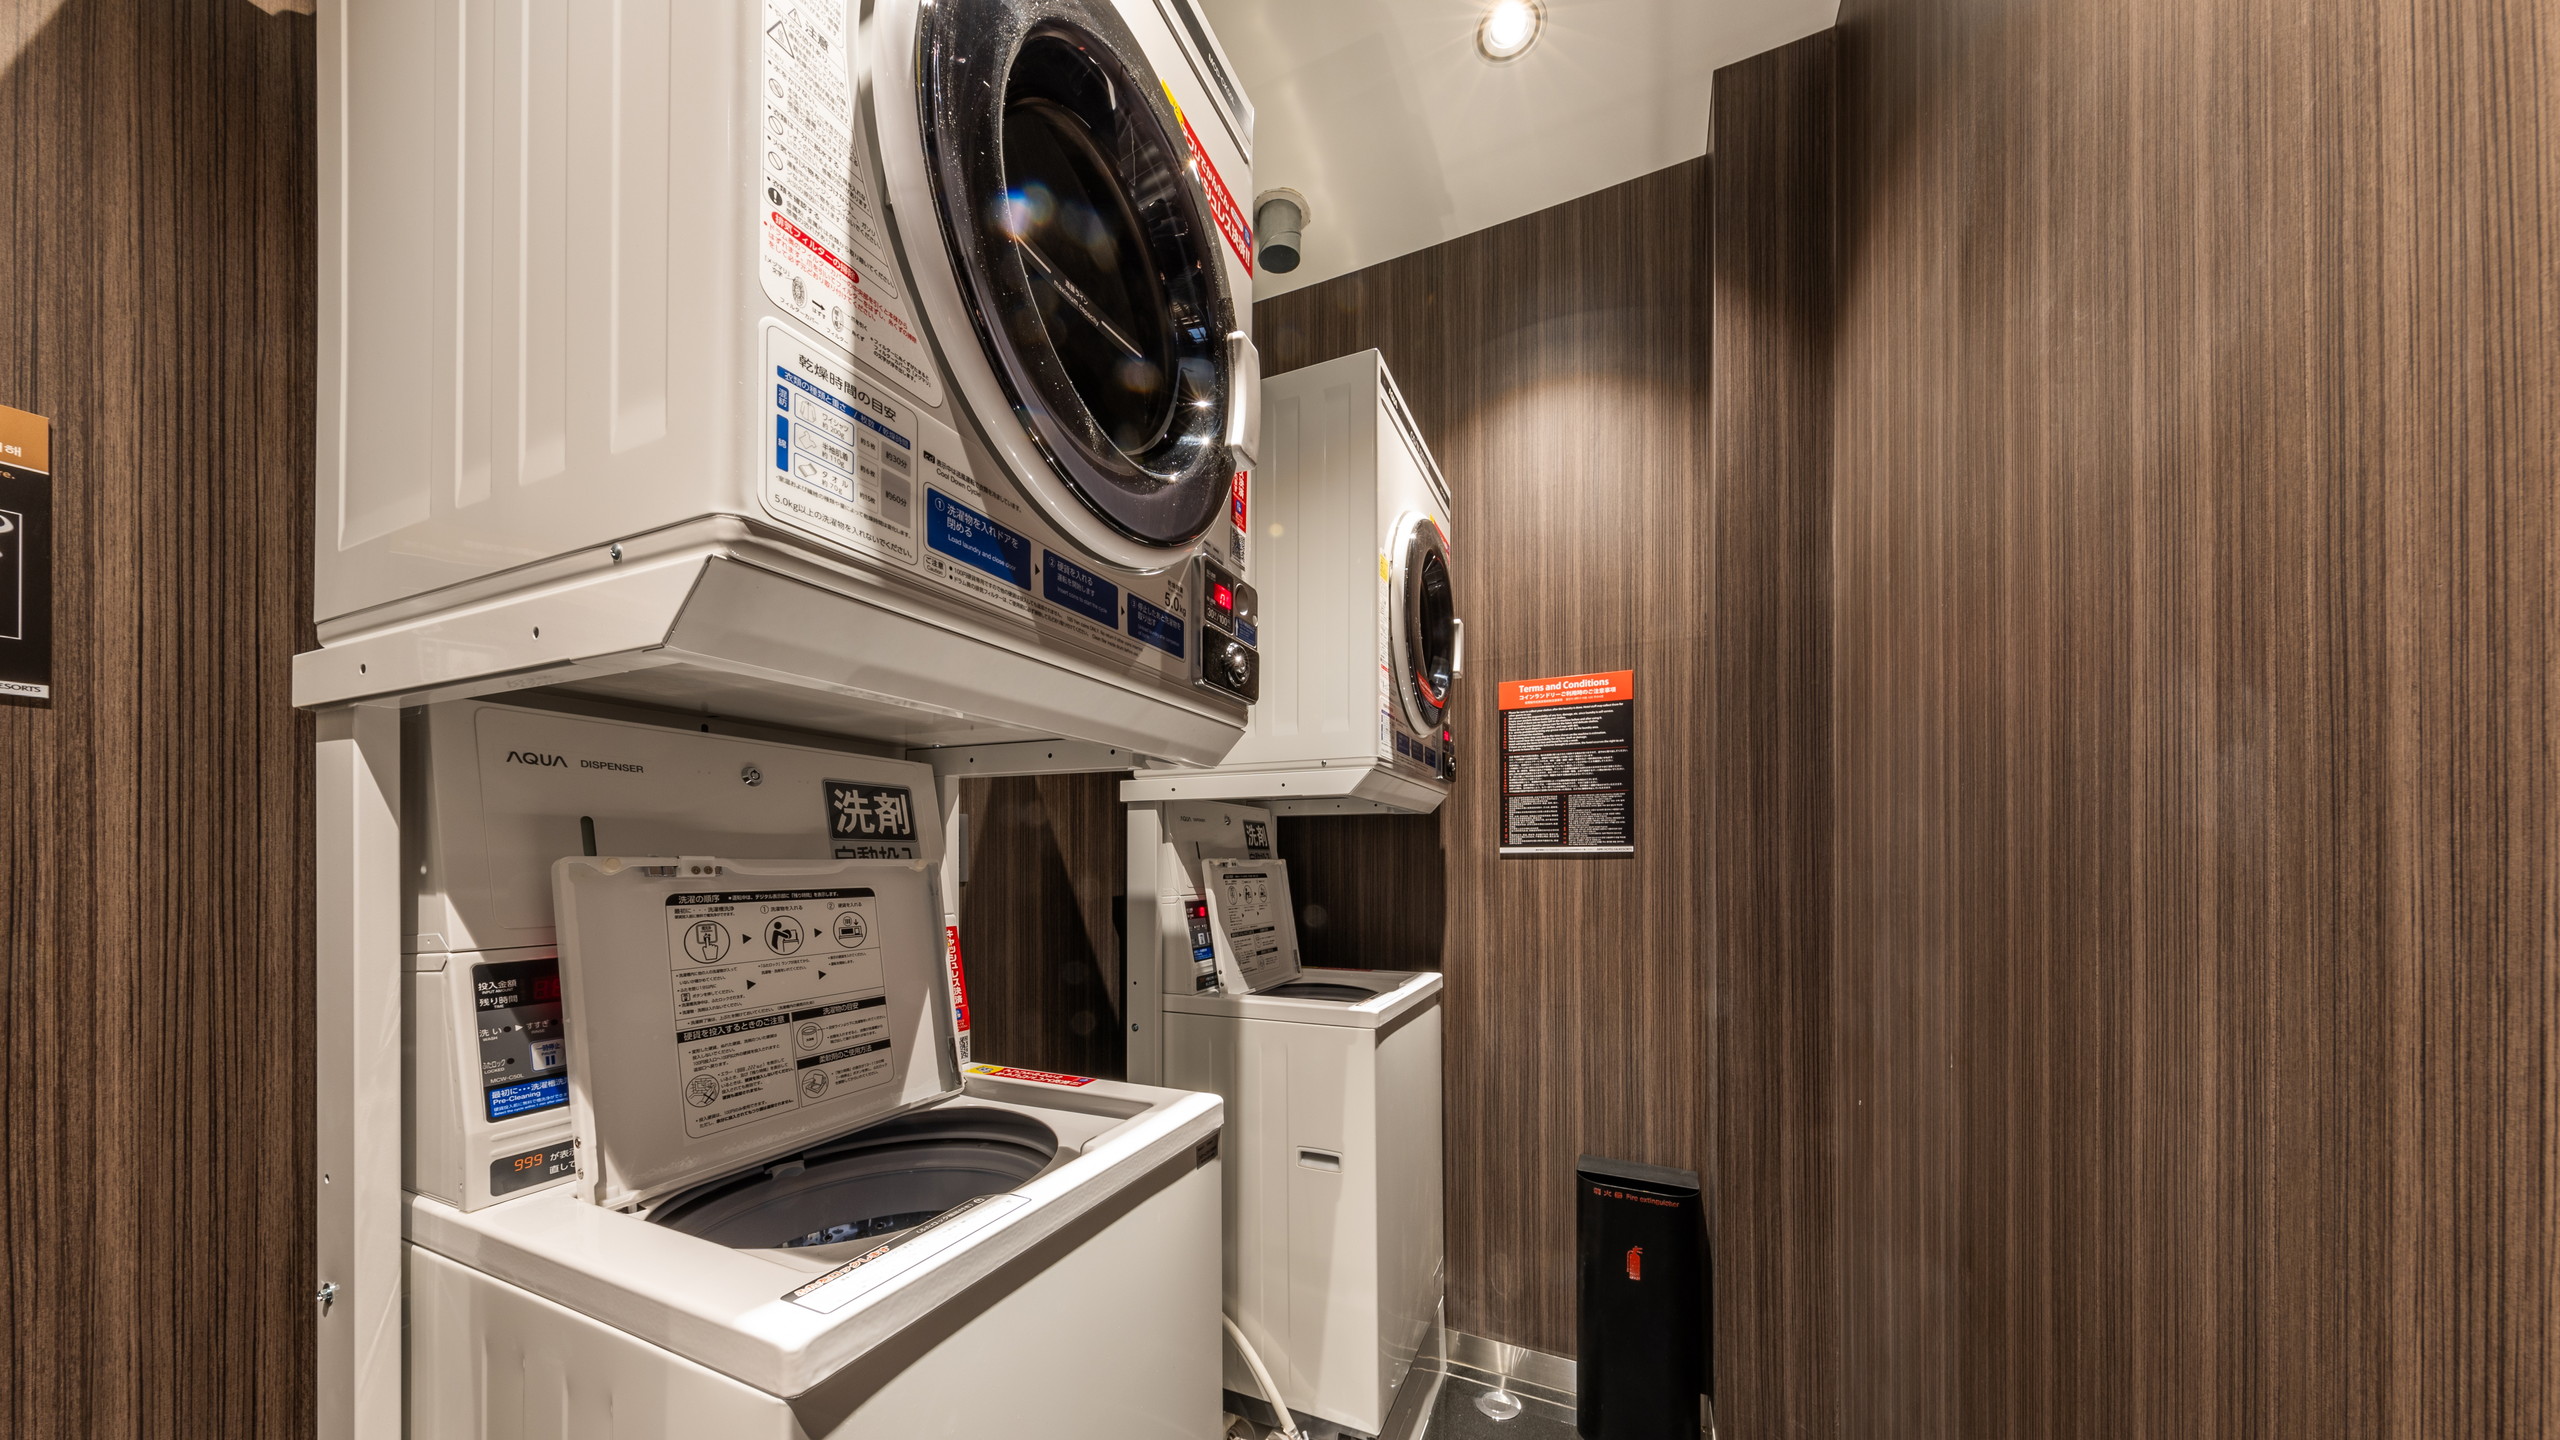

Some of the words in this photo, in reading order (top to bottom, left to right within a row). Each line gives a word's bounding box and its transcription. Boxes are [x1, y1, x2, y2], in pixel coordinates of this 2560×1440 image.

[805, 20, 828, 53] 注意
[774, 211, 855, 282] 排気フィルターの掃除
[784, 371, 847, 413] 衣類の種類と重さ
[798, 353, 897, 423] 乾燥時間の目安
[822, 412, 850, 432] ワイシャツ
[822, 442, 849, 461] 半袖肌着
[885, 452, 908, 469] 約30分
[936, 468, 950, 481] Cool
[950, 474, 966, 490] Down
[885, 490, 907, 507] 約60分
[774, 494, 913, 559] 5.0kg以上の洗濯物を入れないでください。
[946, 517, 973, 538] 閉める
[947, 503, 1018, 549] 洗濯物を入れドアを
[948, 534, 961, 548] Load
[925, 556, 944, 570] ご注意
[1057, 560, 1094, 586] 硬貨を入れる
[1519, 684, 1544, 693] Terms
[1545, 682, 1562, 691] and
[1563, 678, 1609, 689] Conditions
[1519, 686, 1617, 701] コインランドリーご利用時のご注意事項
[506, 751, 568, 768] AQUA
[580, 759, 644, 774] DISPENSER
[833, 789, 911, 835] 洗剤
[1246, 825, 1269, 848] 洗剤
[678, 895, 720, 904] 洗濯の順序
[837, 901, 863, 909] 硬貨を入れる
[769, 904, 804, 913] 洗濯物を入れる
[477, 979, 517, 991] 投入金額
[479, 994, 518, 1007] 残り時間
[822, 1002, 860, 1016] 洗濯物の目安
[479, 1027, 502, 1038] 洗い
[526, 1019, 550, 1029] すすぎ
[683, 1016, 786, 1040] 硬貨を投入するときのご注意
[537, 1042, 562, 1052] 一時停止
[482, 1059, 506, 1070] ふたロック
[484, 1067, 505, 1075] LOCKED
[492, 1076, 568, 1099] 最初に・・・洗濯槽洗
[493, 1090, 541, 1106] Pre-Cleaning
[514, 1153, 543, 1172] 999
[1626, 1193, 1639, 1201] Fire
